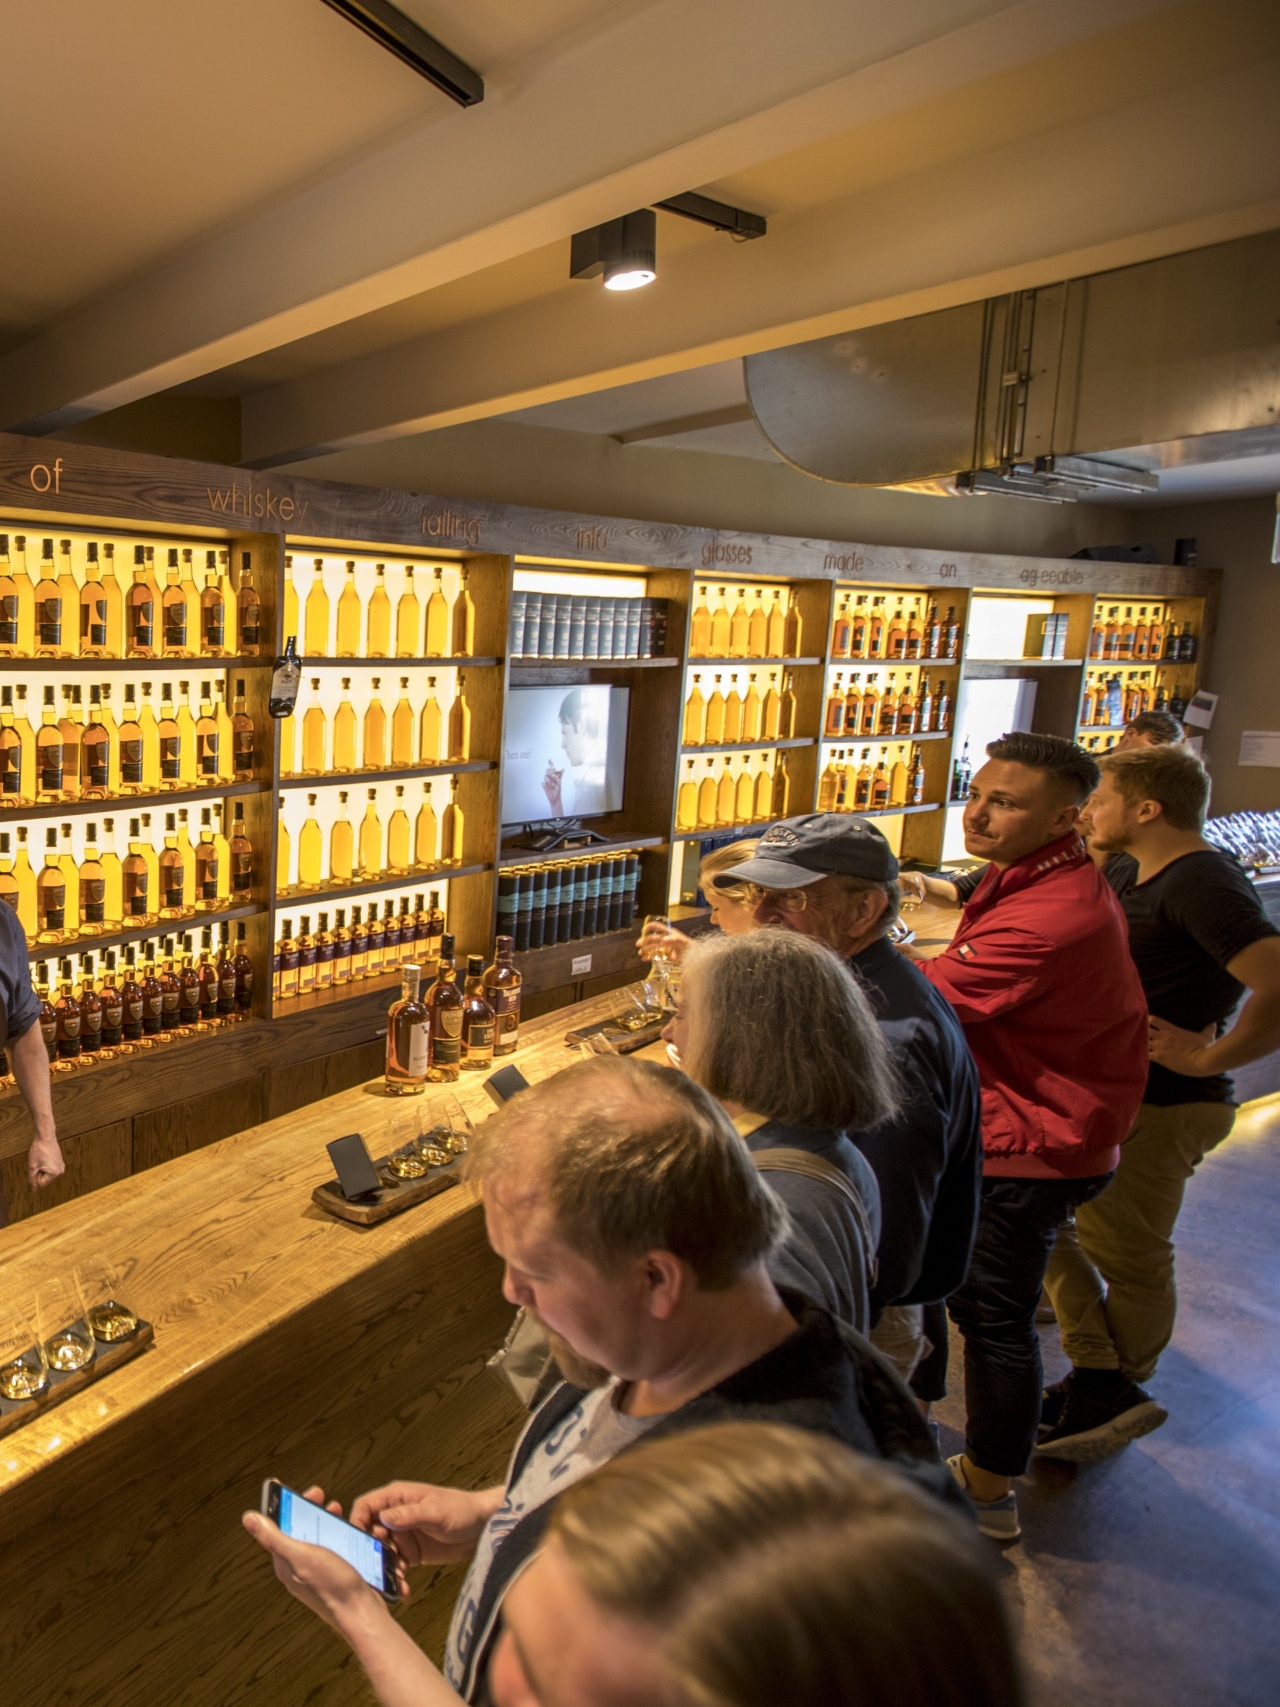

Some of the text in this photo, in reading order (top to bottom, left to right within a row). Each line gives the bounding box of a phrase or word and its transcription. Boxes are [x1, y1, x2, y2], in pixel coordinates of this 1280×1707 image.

[29, 457, 64, 494] of
[206, 483, 308, 528] whiskey
[701, 539, 753, 565] glasses
[823, 551, 864, 572] made
[938, 562, 957, 578] an
[1019, 567, 1084, 587] ageeable
[507, 749, 519, 760] hen
